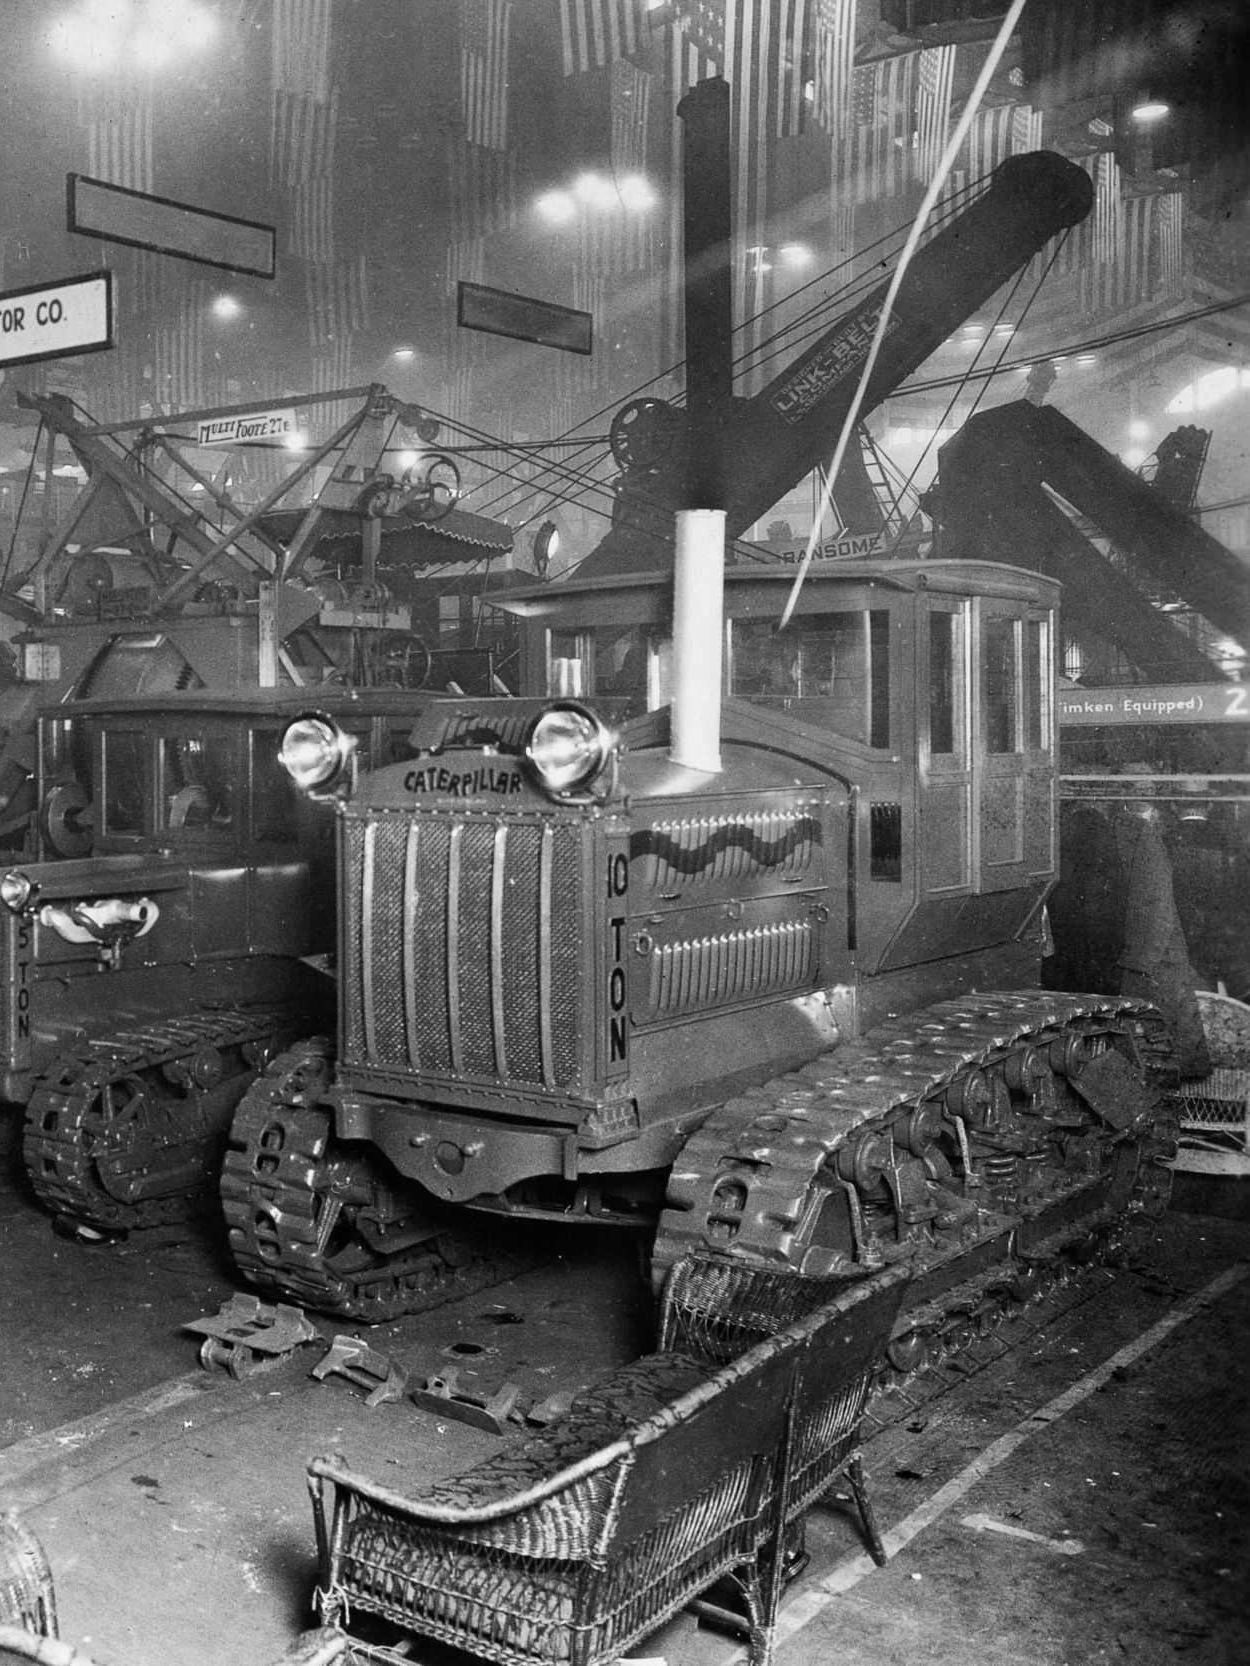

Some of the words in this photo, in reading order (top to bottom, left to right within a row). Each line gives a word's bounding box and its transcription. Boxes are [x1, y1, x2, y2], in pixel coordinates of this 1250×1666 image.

[36, 298, 68, 326] CO.
[199, 420, 235, 444] MULTI
[235, 416, 268, 439] FOOTE
[782, 538, 883, 564] RANSOME
[1123, 694, 1204, 715] Equipped)
[1224, 687, 1250, 715] 2
[403, 766, 522, 797] CATERPILLAR
[606, 853, 629, 899] 10
[17, 921, 34, 950] 5
[17, 961, 30, 1038] TON
[609, 915, 627, 1063] TON
